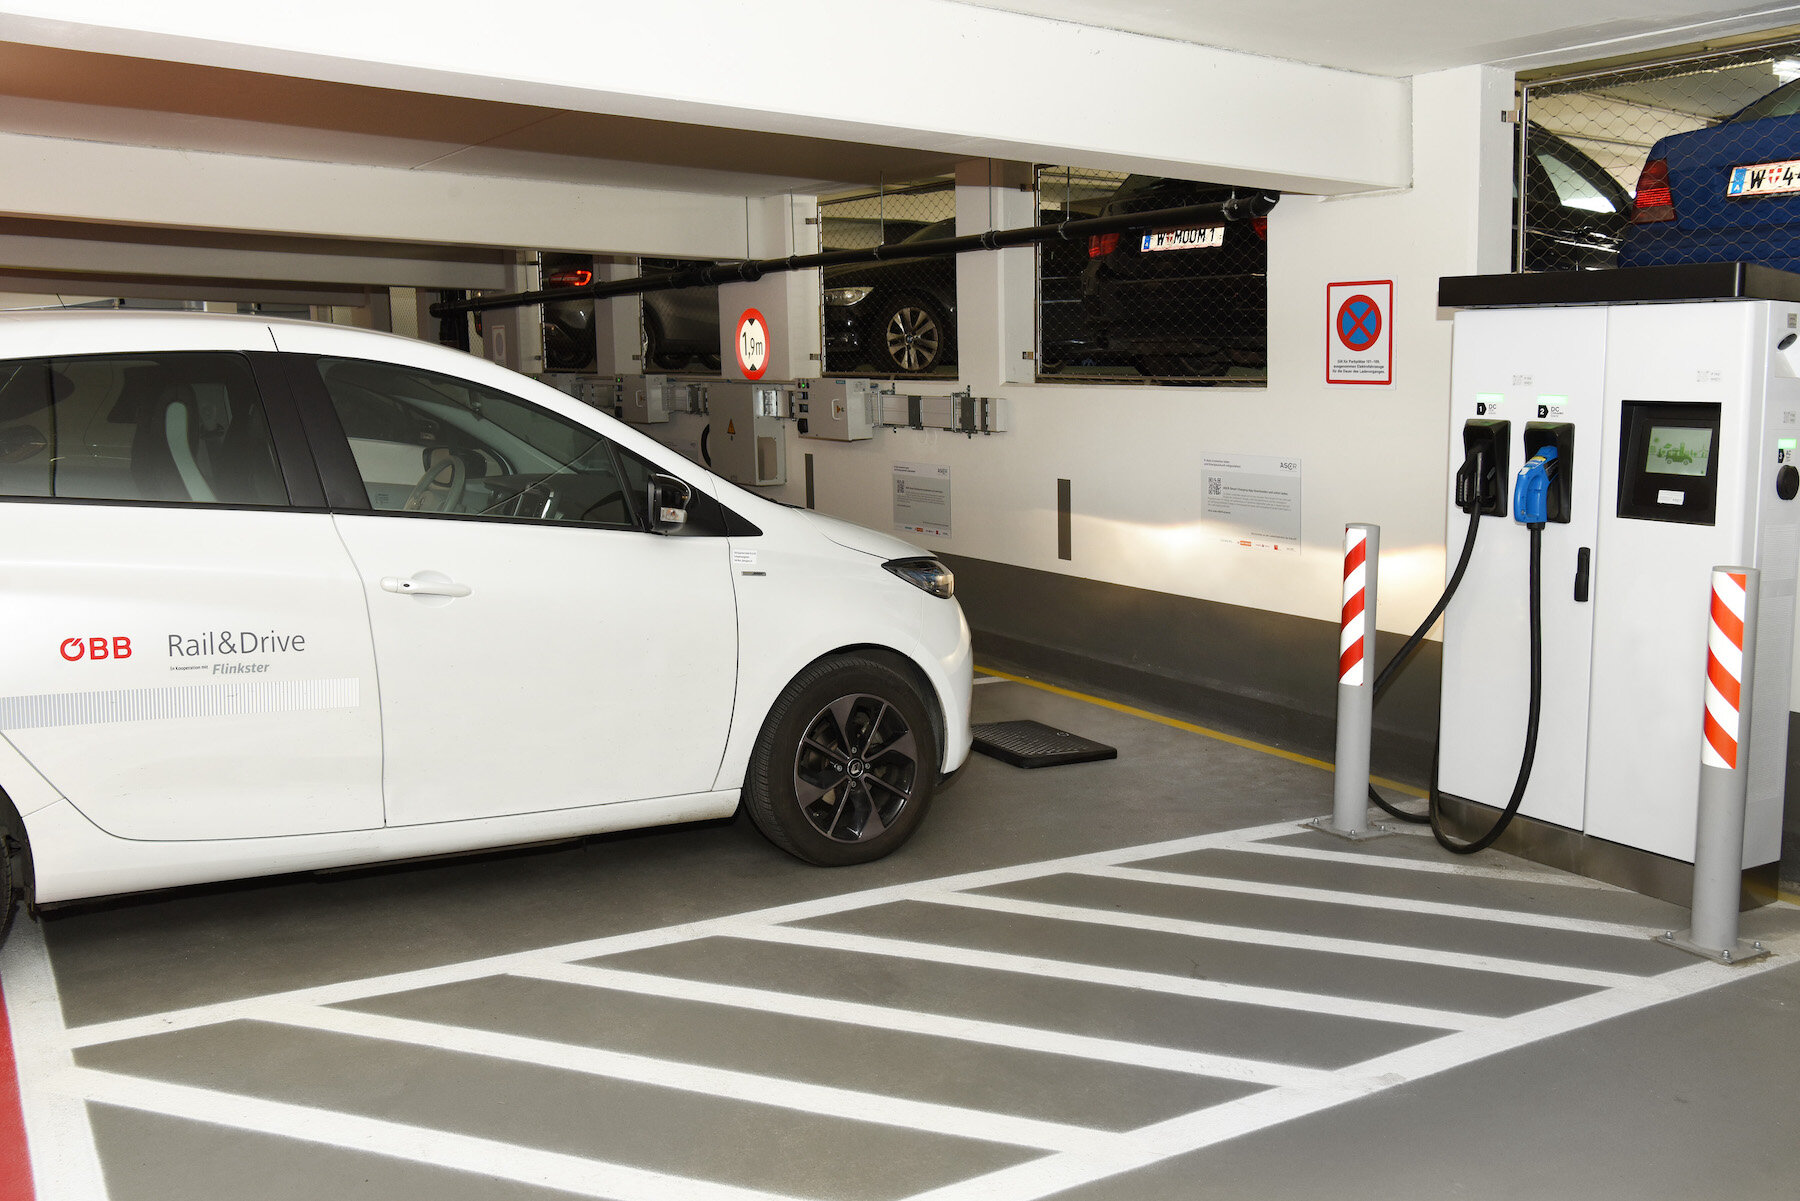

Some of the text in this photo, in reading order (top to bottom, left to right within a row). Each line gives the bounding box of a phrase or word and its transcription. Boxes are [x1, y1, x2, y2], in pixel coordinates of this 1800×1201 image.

[1750, 169, 1766, 189] W
[1158, 232, 1165, 246] W
[1210, 228, 1215, 242] 1
[60, 636, 132, 662] ÖBB
[168, 630, 305, 657] Rail&Drive
[212, 663, 270, 675] Flinkster
